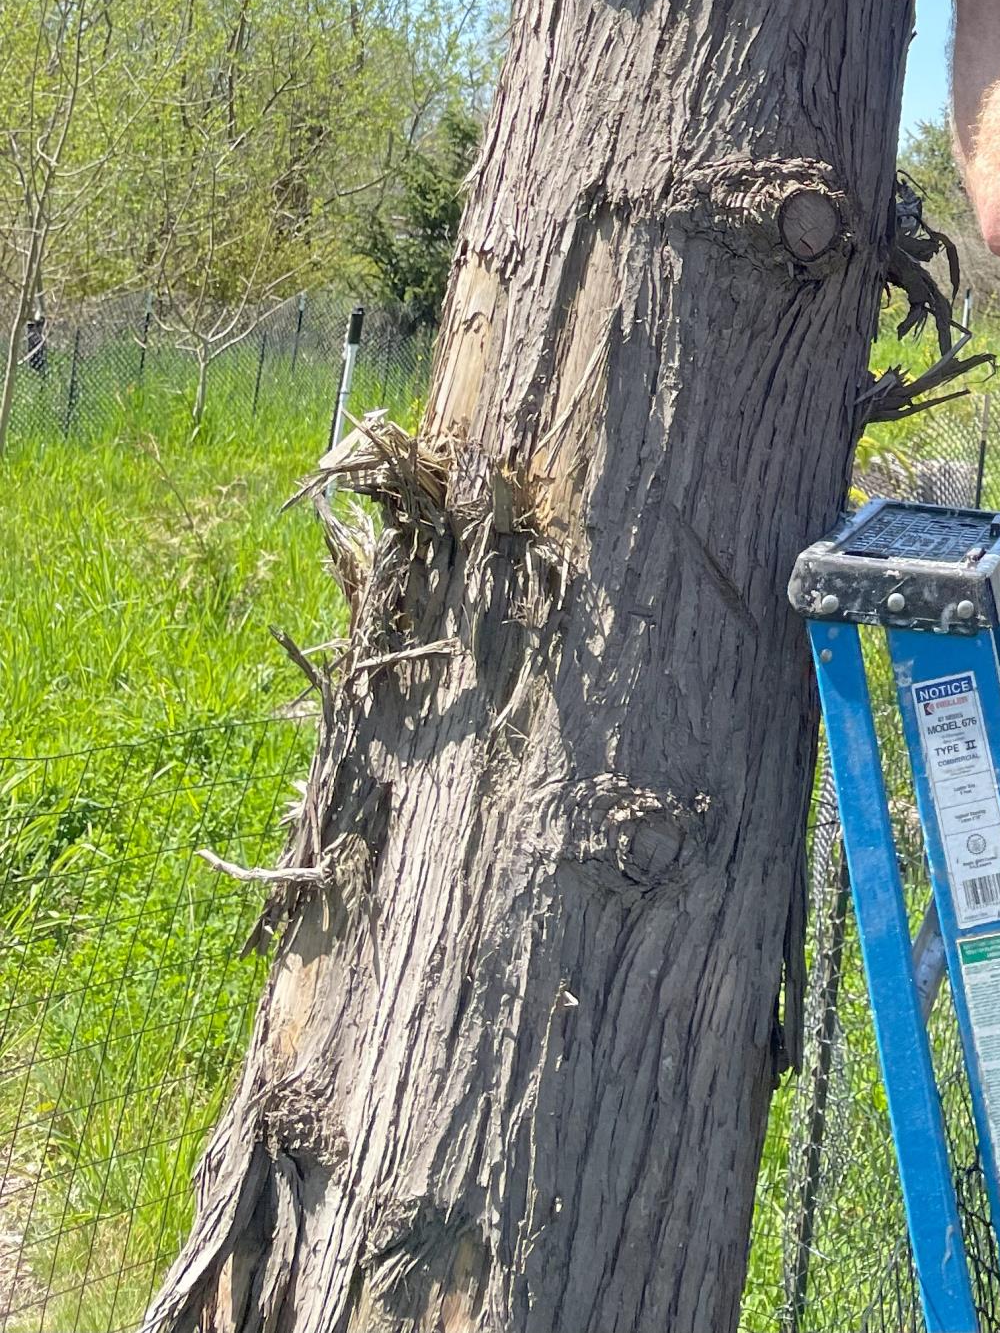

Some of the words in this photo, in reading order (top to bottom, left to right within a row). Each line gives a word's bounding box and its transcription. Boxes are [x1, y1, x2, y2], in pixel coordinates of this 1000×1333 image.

[919, 680, 969, 701] NOTICE
[927, 720, 961, 735] MODEL
[934, 744, 960, 756] TYPE
